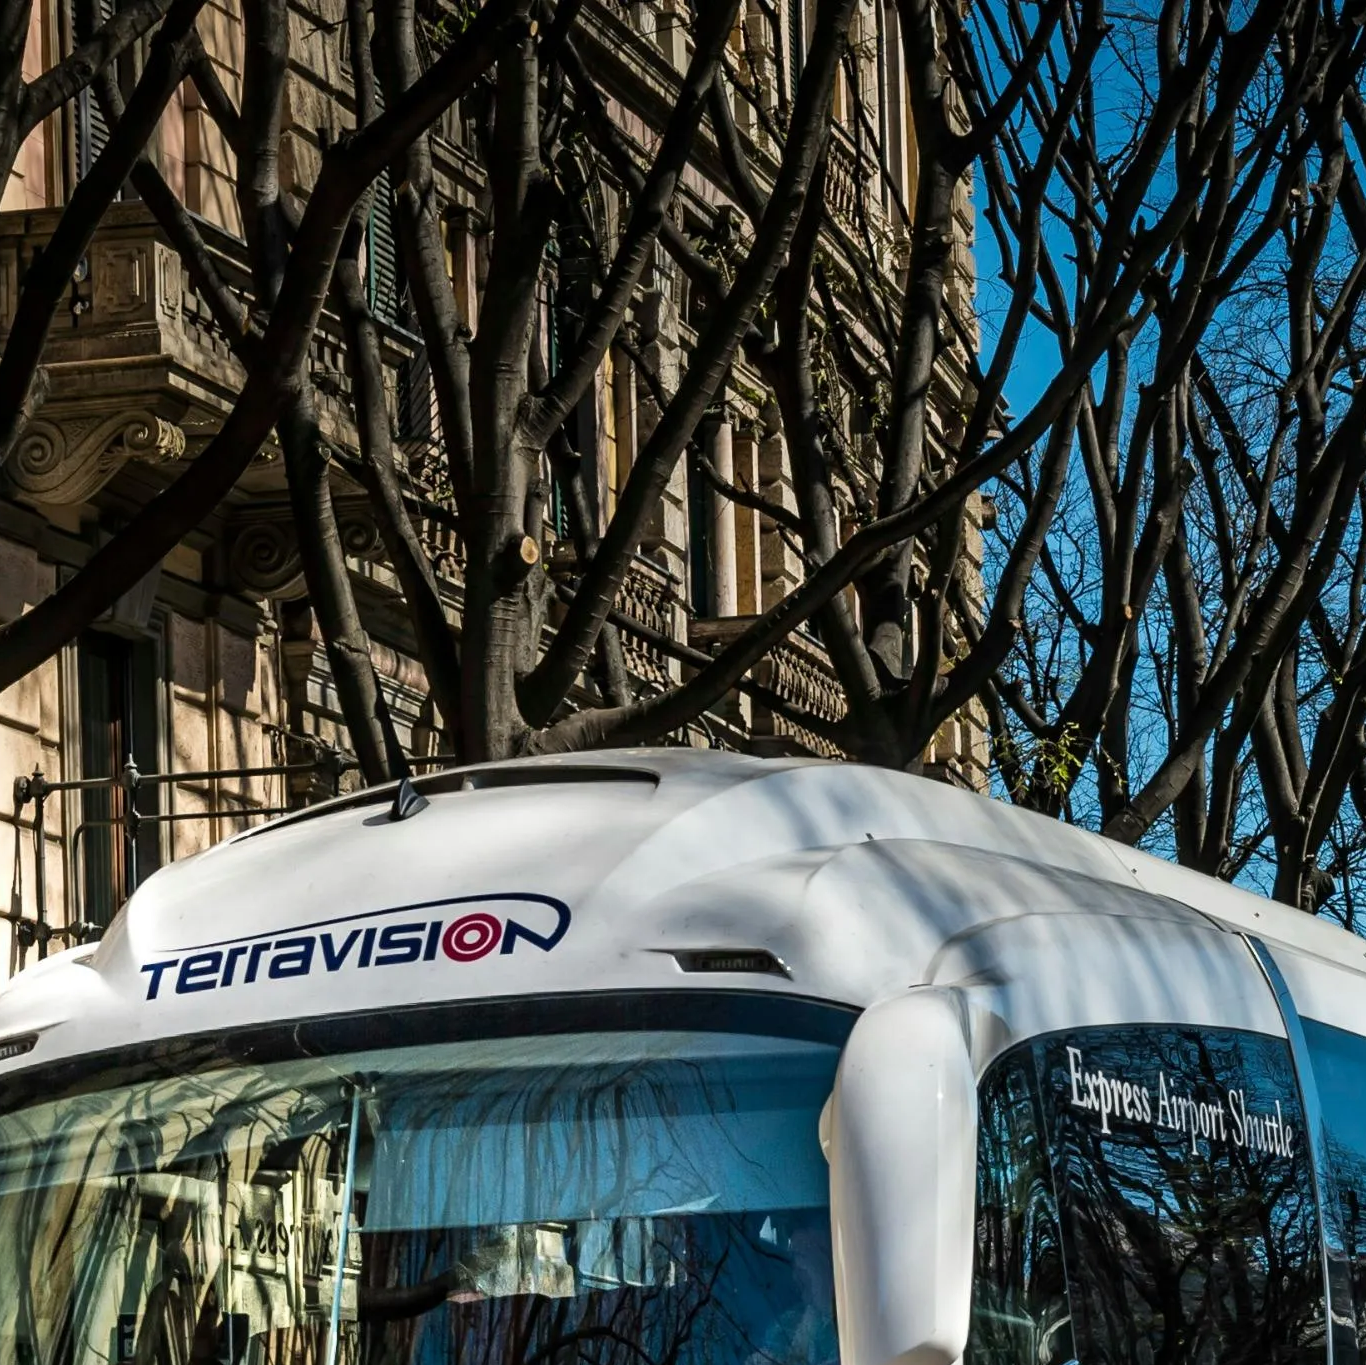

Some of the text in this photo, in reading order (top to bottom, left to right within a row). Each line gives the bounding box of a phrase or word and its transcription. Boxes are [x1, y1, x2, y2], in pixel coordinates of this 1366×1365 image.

[1066, 1045, 1294, 1159] Express Airport Shuttle
